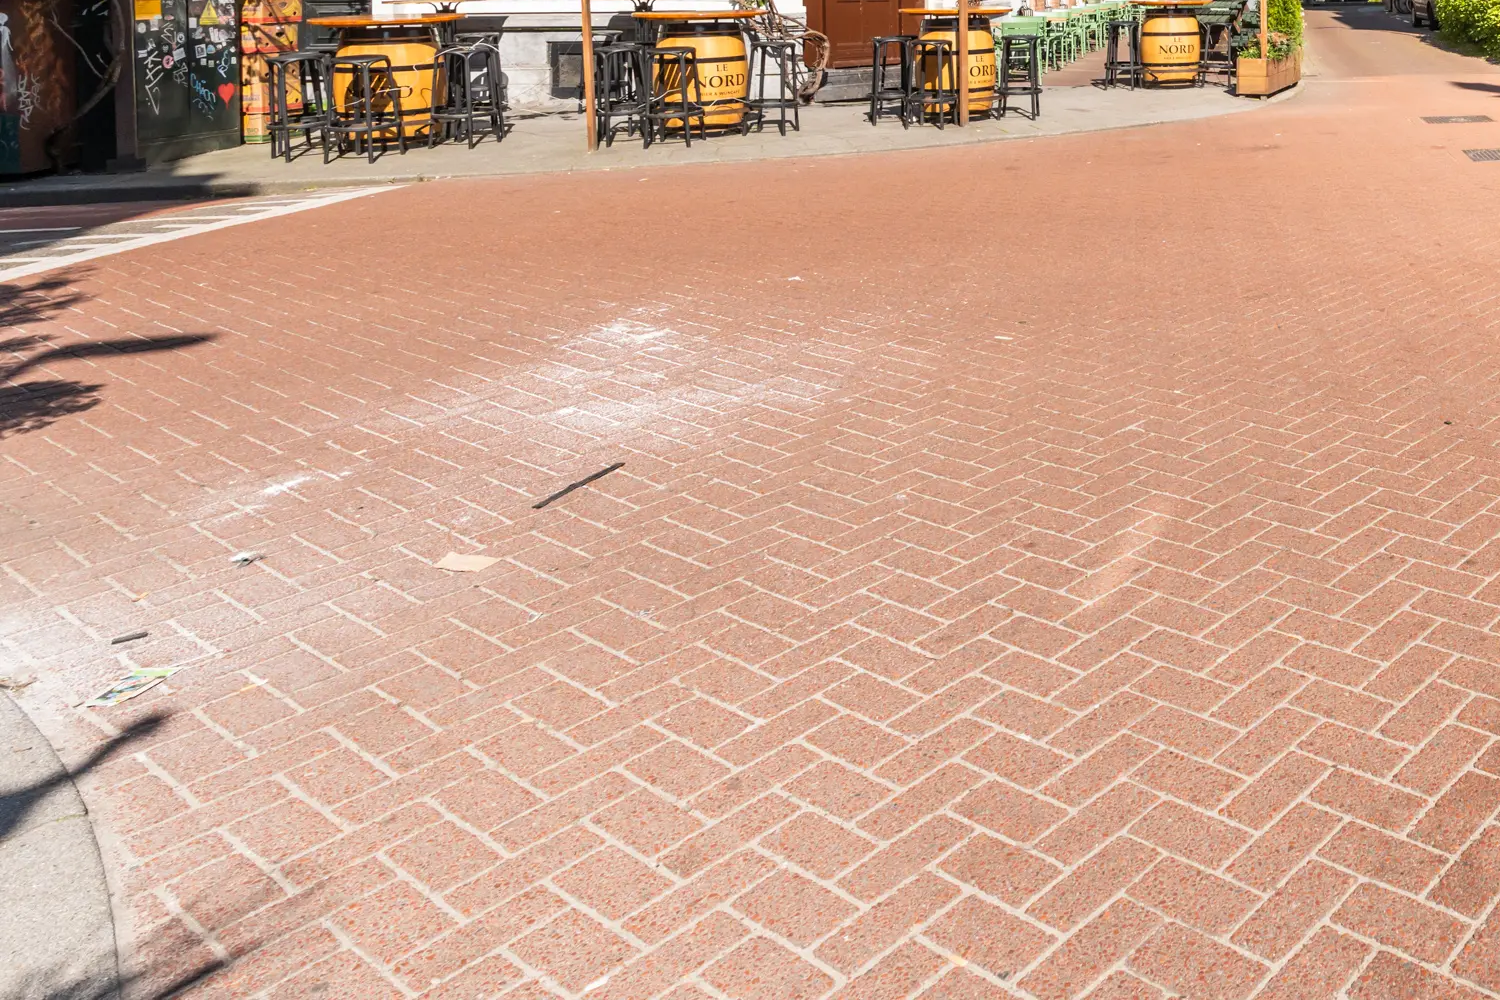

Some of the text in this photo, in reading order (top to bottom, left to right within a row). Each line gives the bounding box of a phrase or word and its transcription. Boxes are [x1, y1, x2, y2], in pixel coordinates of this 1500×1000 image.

[1159, 45, 1194, 54] NORD
[716, 64, 728, 72] LE
[970, 64, 996, 77] ORD
